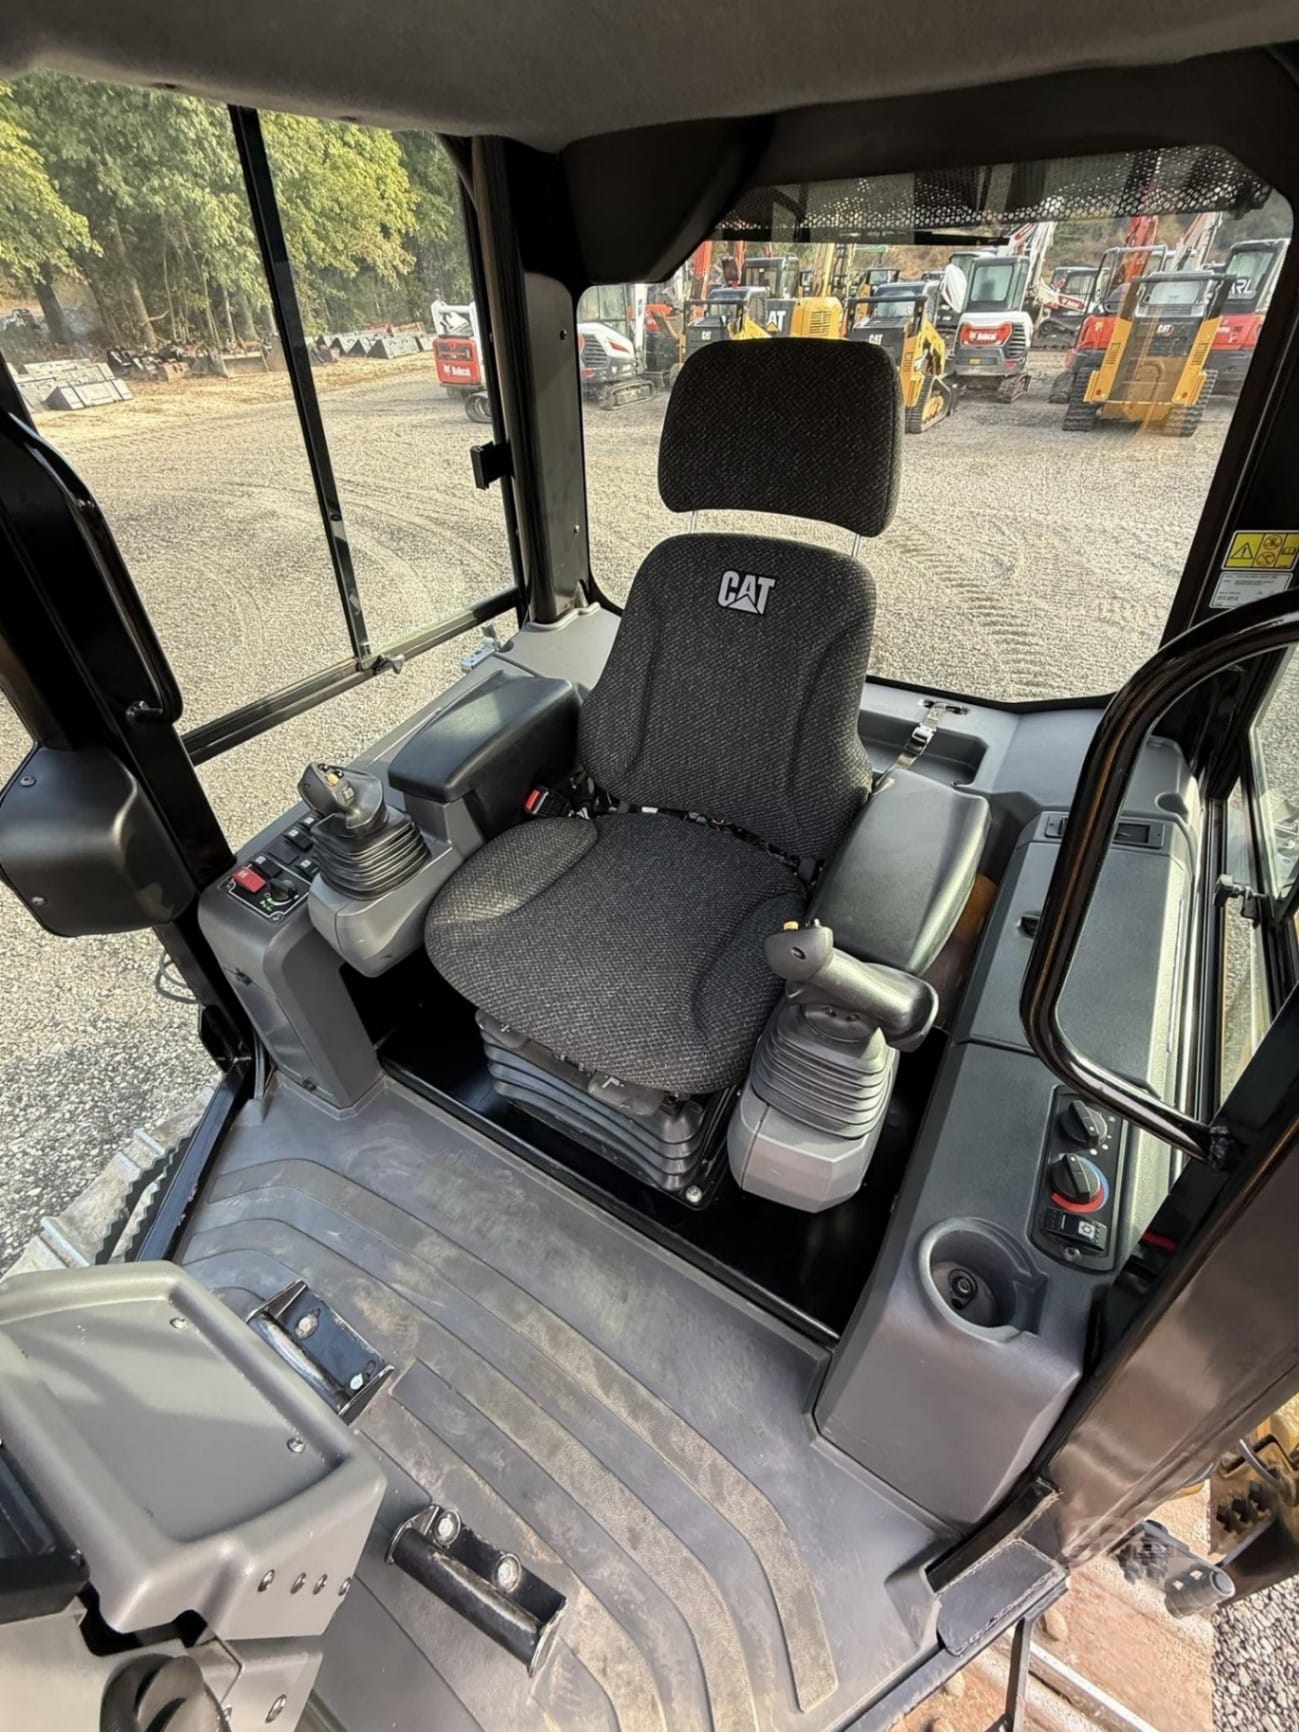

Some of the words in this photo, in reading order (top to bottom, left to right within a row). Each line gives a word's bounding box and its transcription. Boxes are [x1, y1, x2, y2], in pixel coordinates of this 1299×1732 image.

[769, 310, 786, 332] AT
[868, 334, 883, 345] CAT
[718, 570, 776, 614] CAT
